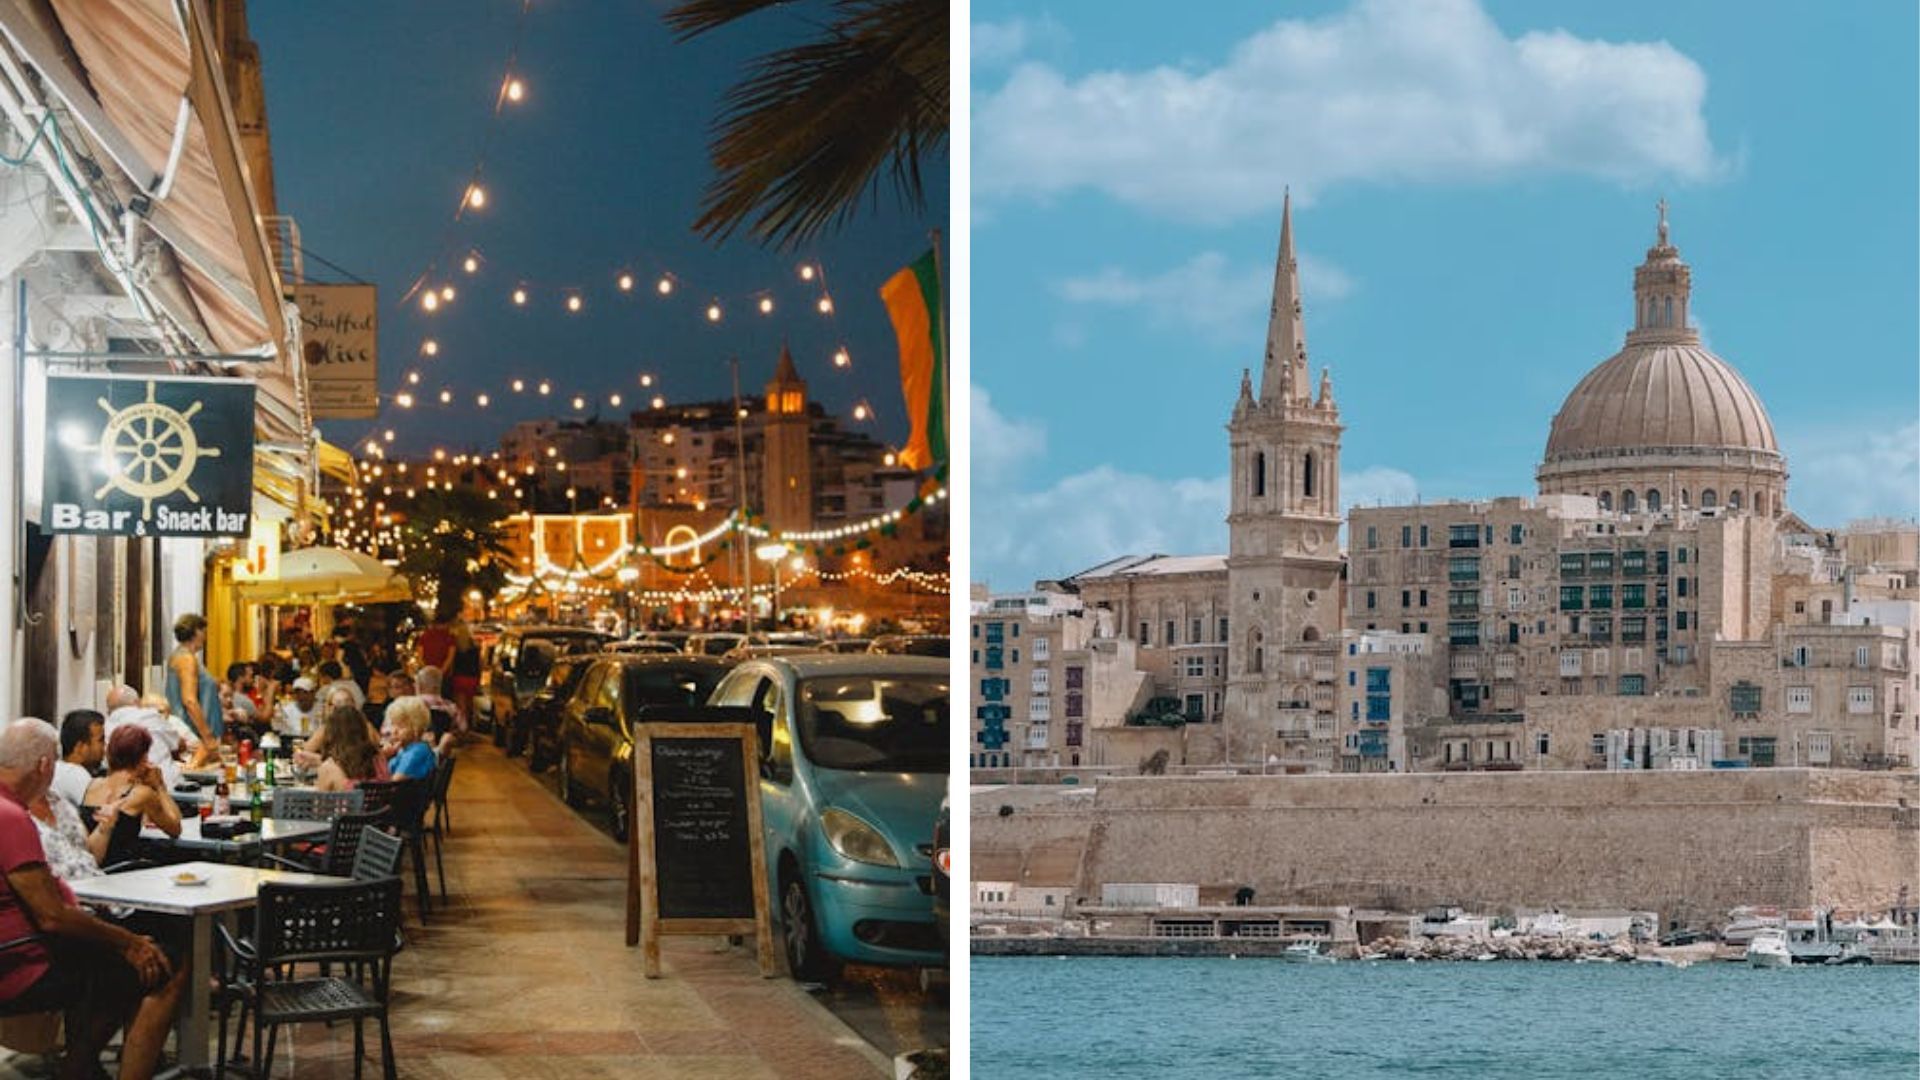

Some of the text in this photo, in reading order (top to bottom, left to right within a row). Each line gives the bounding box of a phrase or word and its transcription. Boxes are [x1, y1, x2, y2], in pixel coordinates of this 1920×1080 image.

[300, 309, 372, 334] Stuffed
[51, 503, 247, 536] Bar & Snack bar
